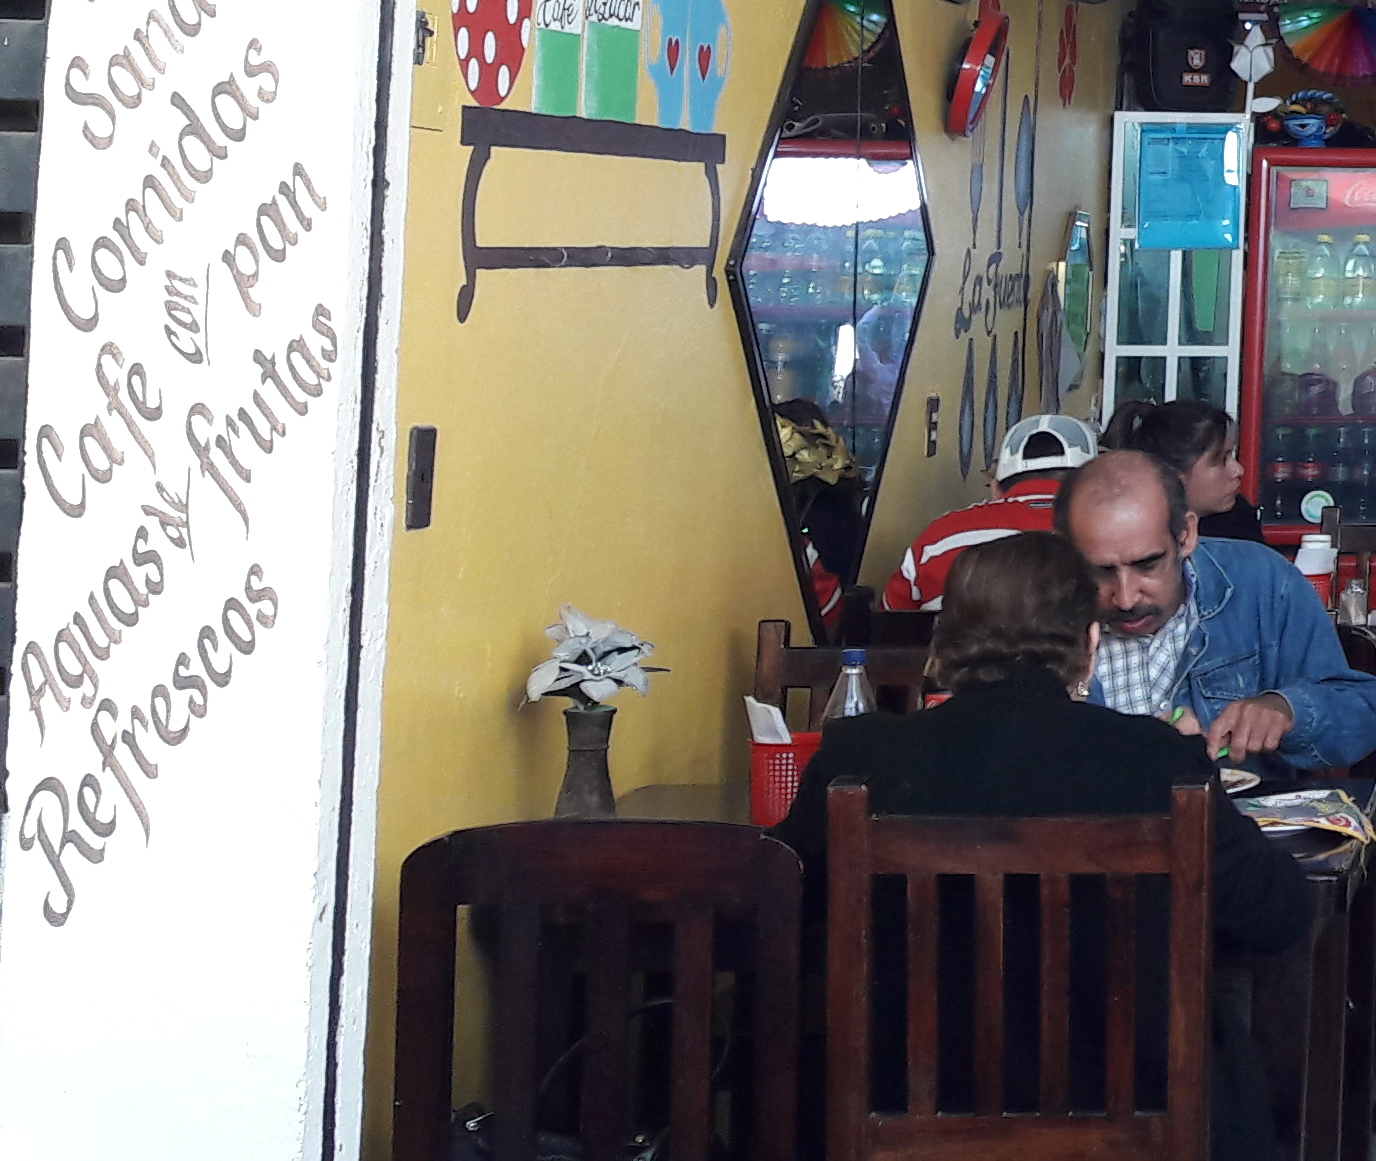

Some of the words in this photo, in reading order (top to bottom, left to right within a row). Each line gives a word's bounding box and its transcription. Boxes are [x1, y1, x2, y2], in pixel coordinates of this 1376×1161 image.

[36, 340, 164, 519] Cafe
[164, 269, 205, 366] con
[220, 161, 328, 317] pan
[52, 37, 281, 333] Comidas
[954, 246, 984, 340] La
[20, 524, 166, 748] Aguas
[186, 302, 338, 541] frutas
[20, 563, 280, 928] Refrescos
